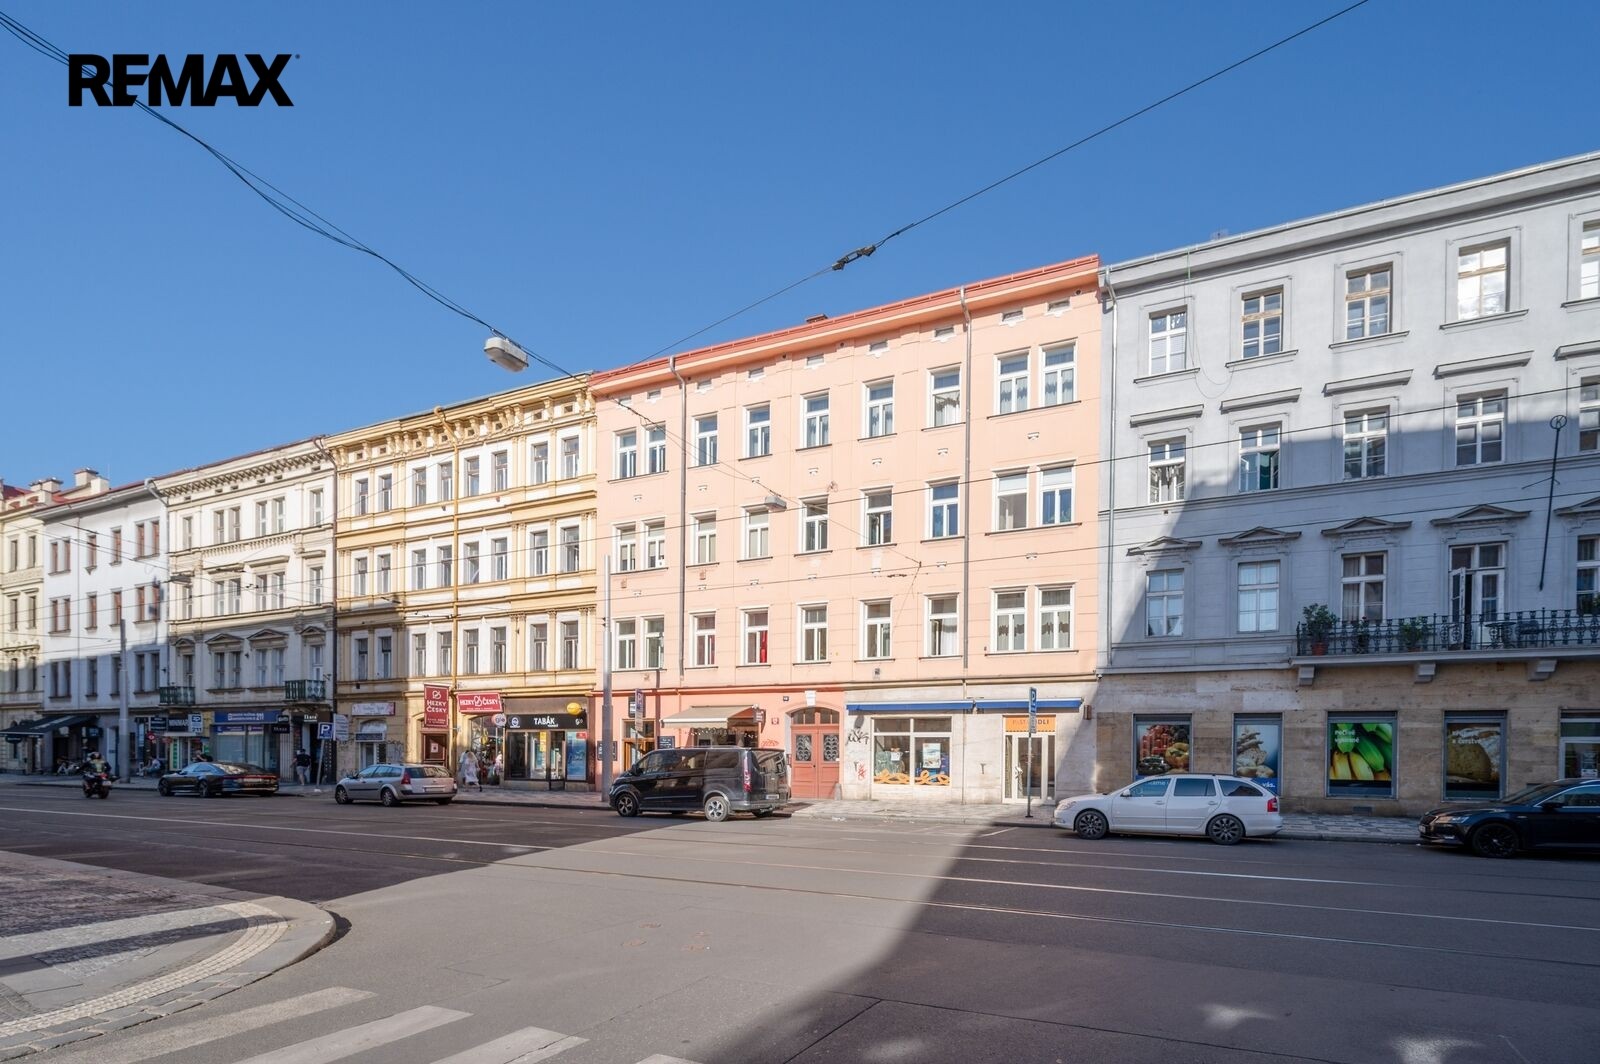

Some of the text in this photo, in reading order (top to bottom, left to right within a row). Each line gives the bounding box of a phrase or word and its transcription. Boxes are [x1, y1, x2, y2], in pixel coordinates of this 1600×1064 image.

[427, 699, 447, 707] HEZKY
[426, 705, 448, 713] ČESKY
[533, 716, 555, 725] TABÁK
[321, 724, 330, 735] P
